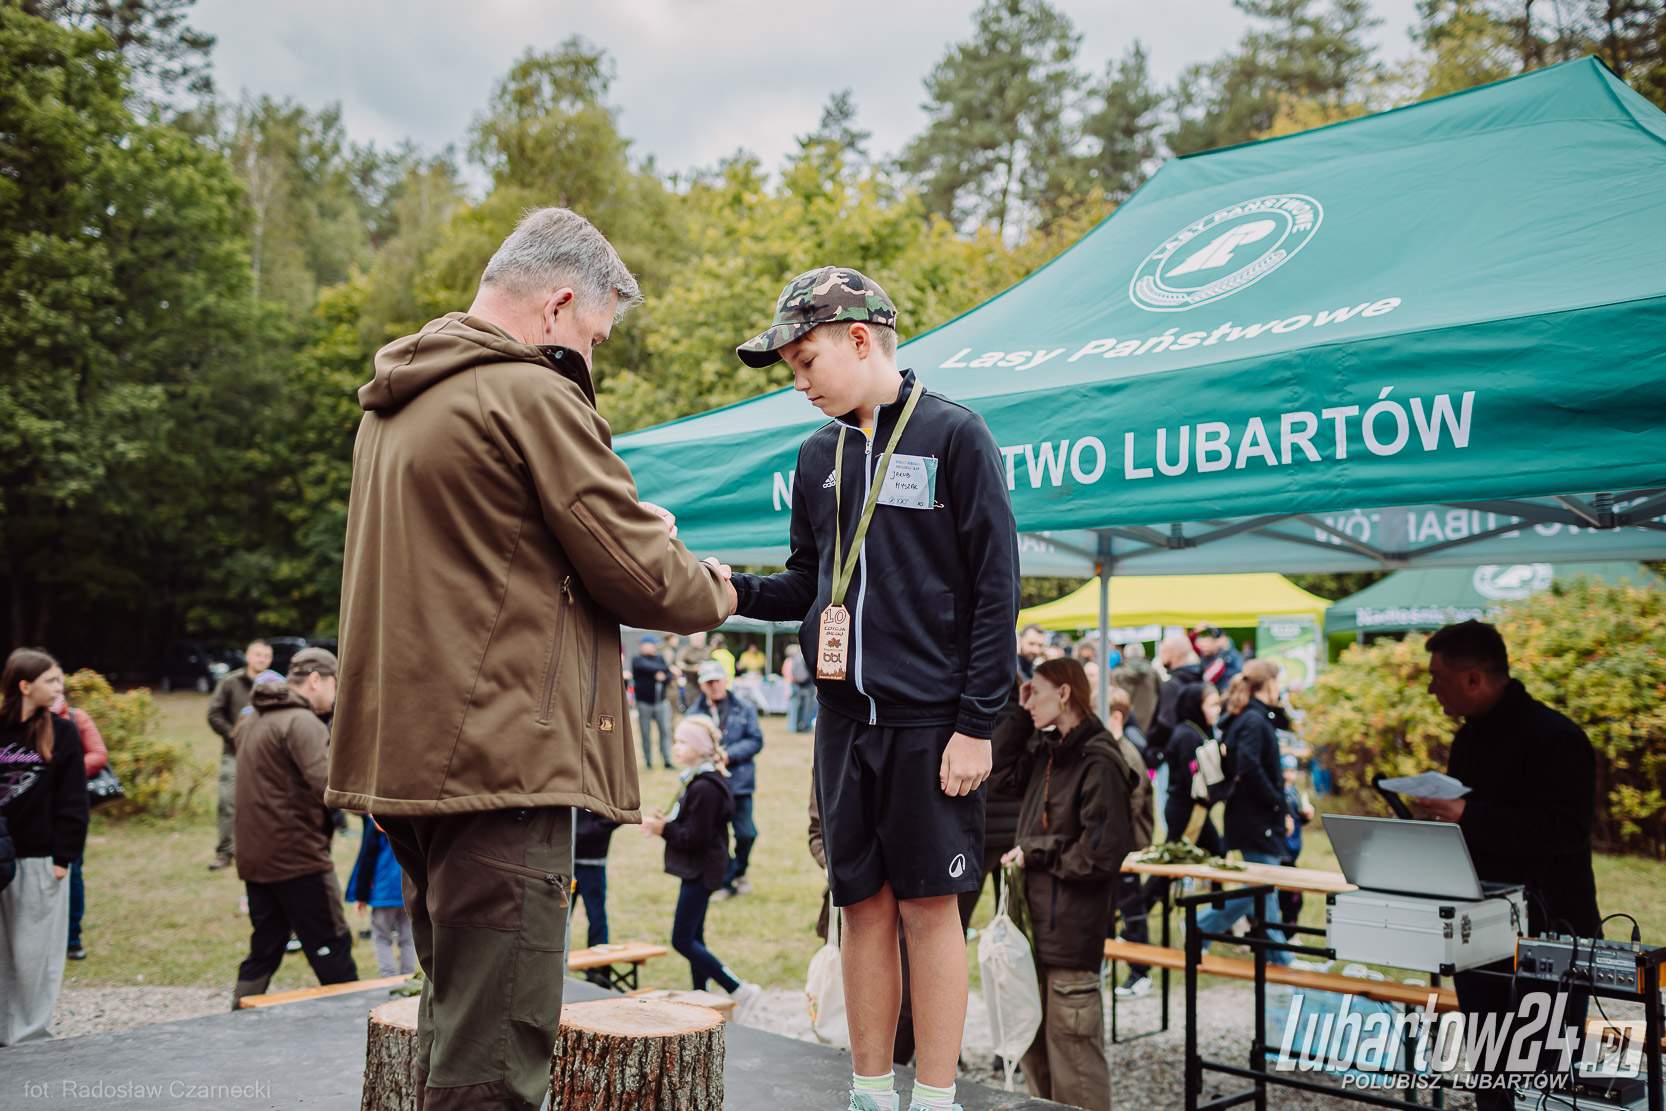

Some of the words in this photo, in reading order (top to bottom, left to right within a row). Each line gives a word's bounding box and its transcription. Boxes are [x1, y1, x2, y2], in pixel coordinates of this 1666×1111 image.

[939, 348, 1066, 371] Lasy
[1067, 298, 1401, 362] Państwowe
[1124, 386, 1475, 480] LUBARTÓW
[824, 608, 846, 624] 10
